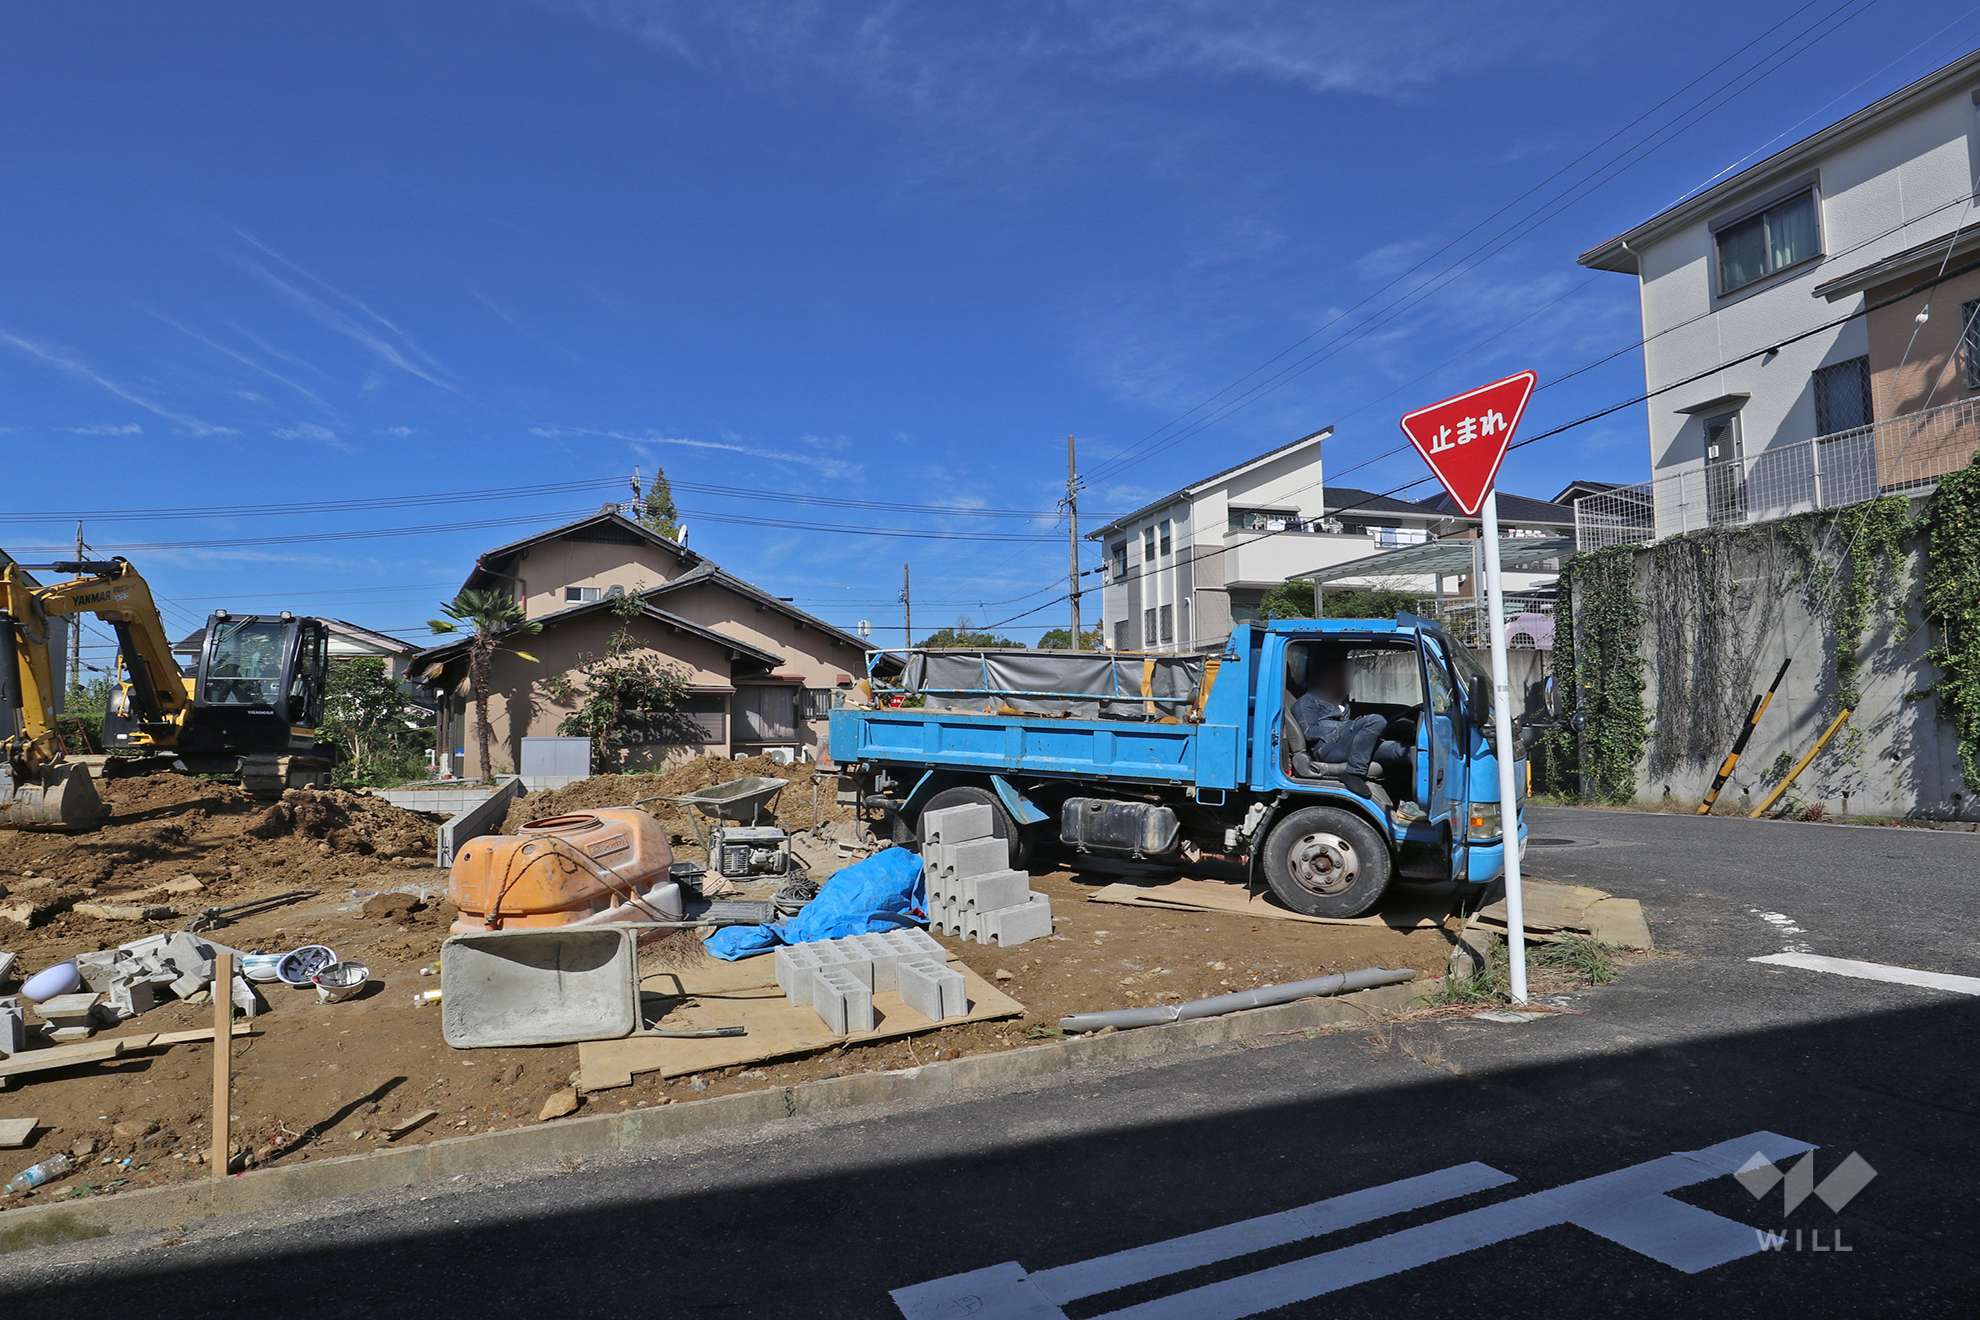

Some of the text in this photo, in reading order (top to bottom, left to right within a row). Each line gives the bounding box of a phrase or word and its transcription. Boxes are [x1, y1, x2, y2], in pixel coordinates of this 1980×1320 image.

[1429, 408, 1508, 455] 止まれ
[72, 590, 111, 607] YANMAR
